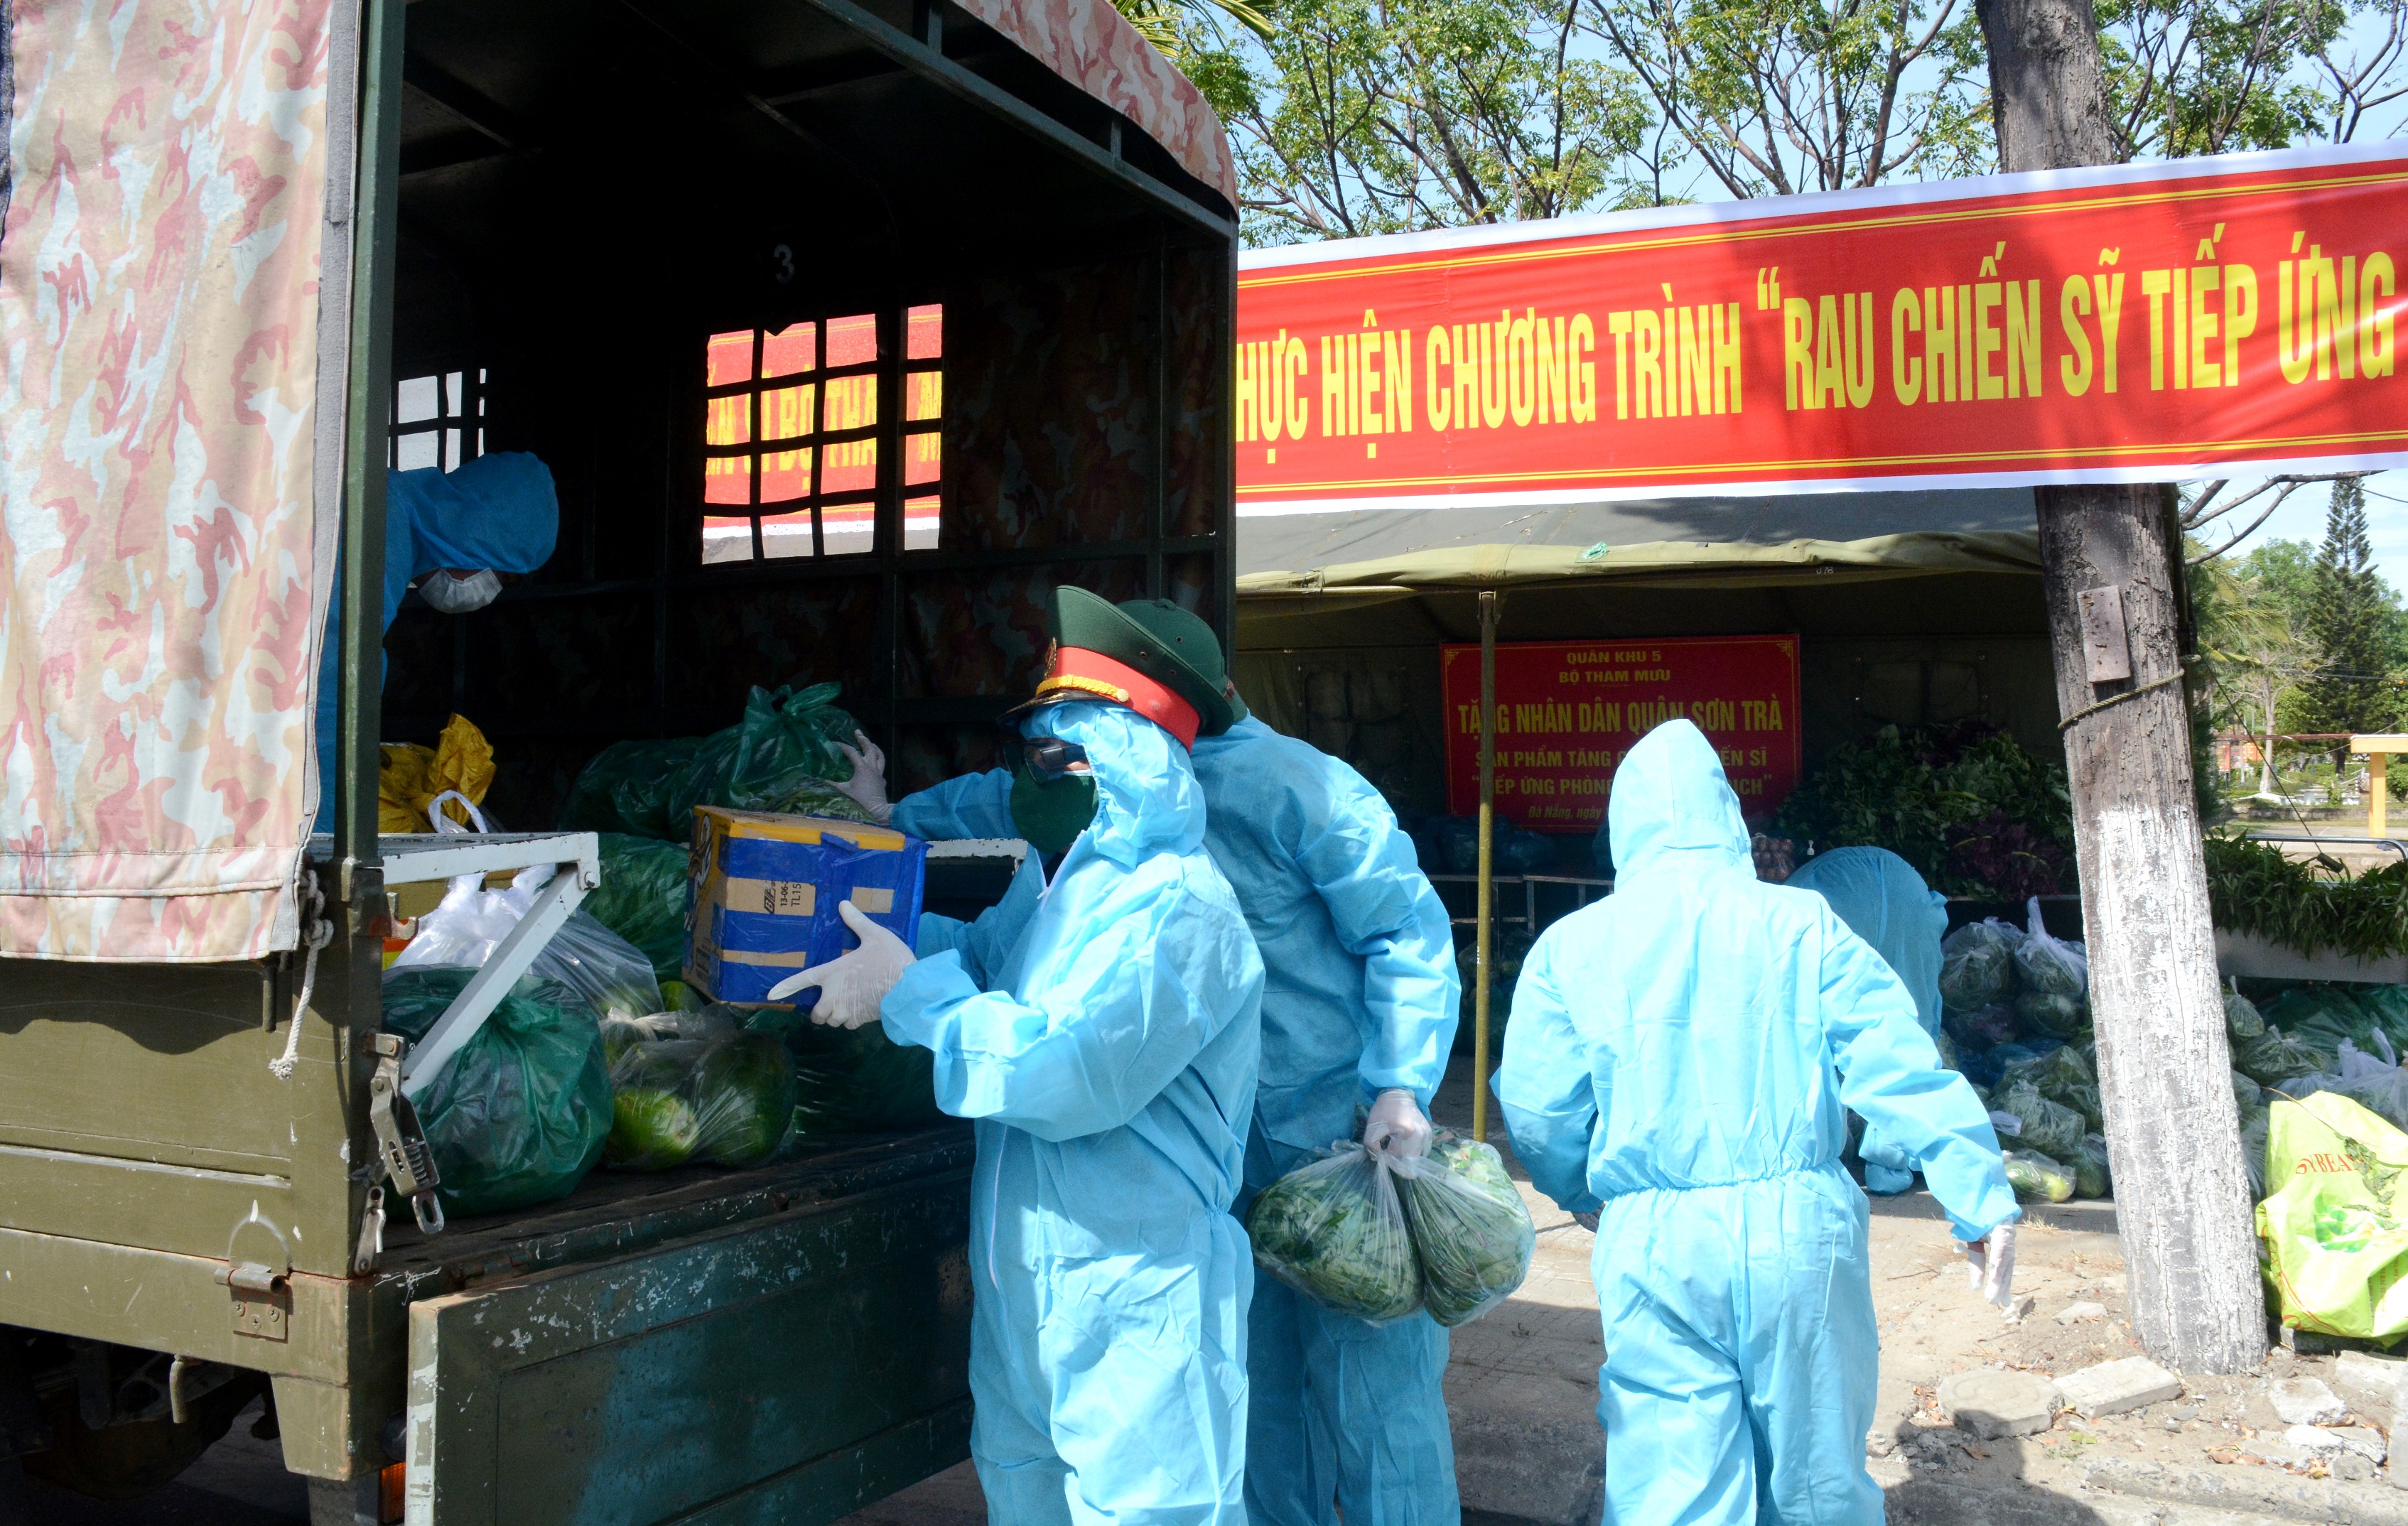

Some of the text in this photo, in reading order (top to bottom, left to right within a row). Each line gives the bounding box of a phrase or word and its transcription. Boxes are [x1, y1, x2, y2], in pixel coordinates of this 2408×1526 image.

[774, 243, 795, 283] 3
[1320, 308, 1413, 459] HIỆN
[1425, 306, 1597, 432] CHƯƠNG
[1608, 282, 1743, 421] TRÌNH
[1891, 240, 2043, 405] CHIẾN
[2061, 247, 2126, 397] SỸ
[2142, 222, 2259, 391] TIẾP
[2278, 230, 2395, 384] ỨNG
[1567, 649, 1662, 665] QUÂN KHU 5
[1558, 669, 1671, 686] BỘ THAM MƯU
[1457, 698, 1510, 740] TẶG
[1516, 697, 1573, 733] NHÂN
[1578, 696, 1621, 732] DÂN
[1690, 698, 1735, 732] SƠN
[1741, 693, 1783, 731] TRÀ
[1513, 745, 1562, 767] PHẨM
[1567, 747, 1611, 767] TĂNG
[1749, 747, 1767, 767] SĨ
[1521, 774, 1555, 795] ỨNG
